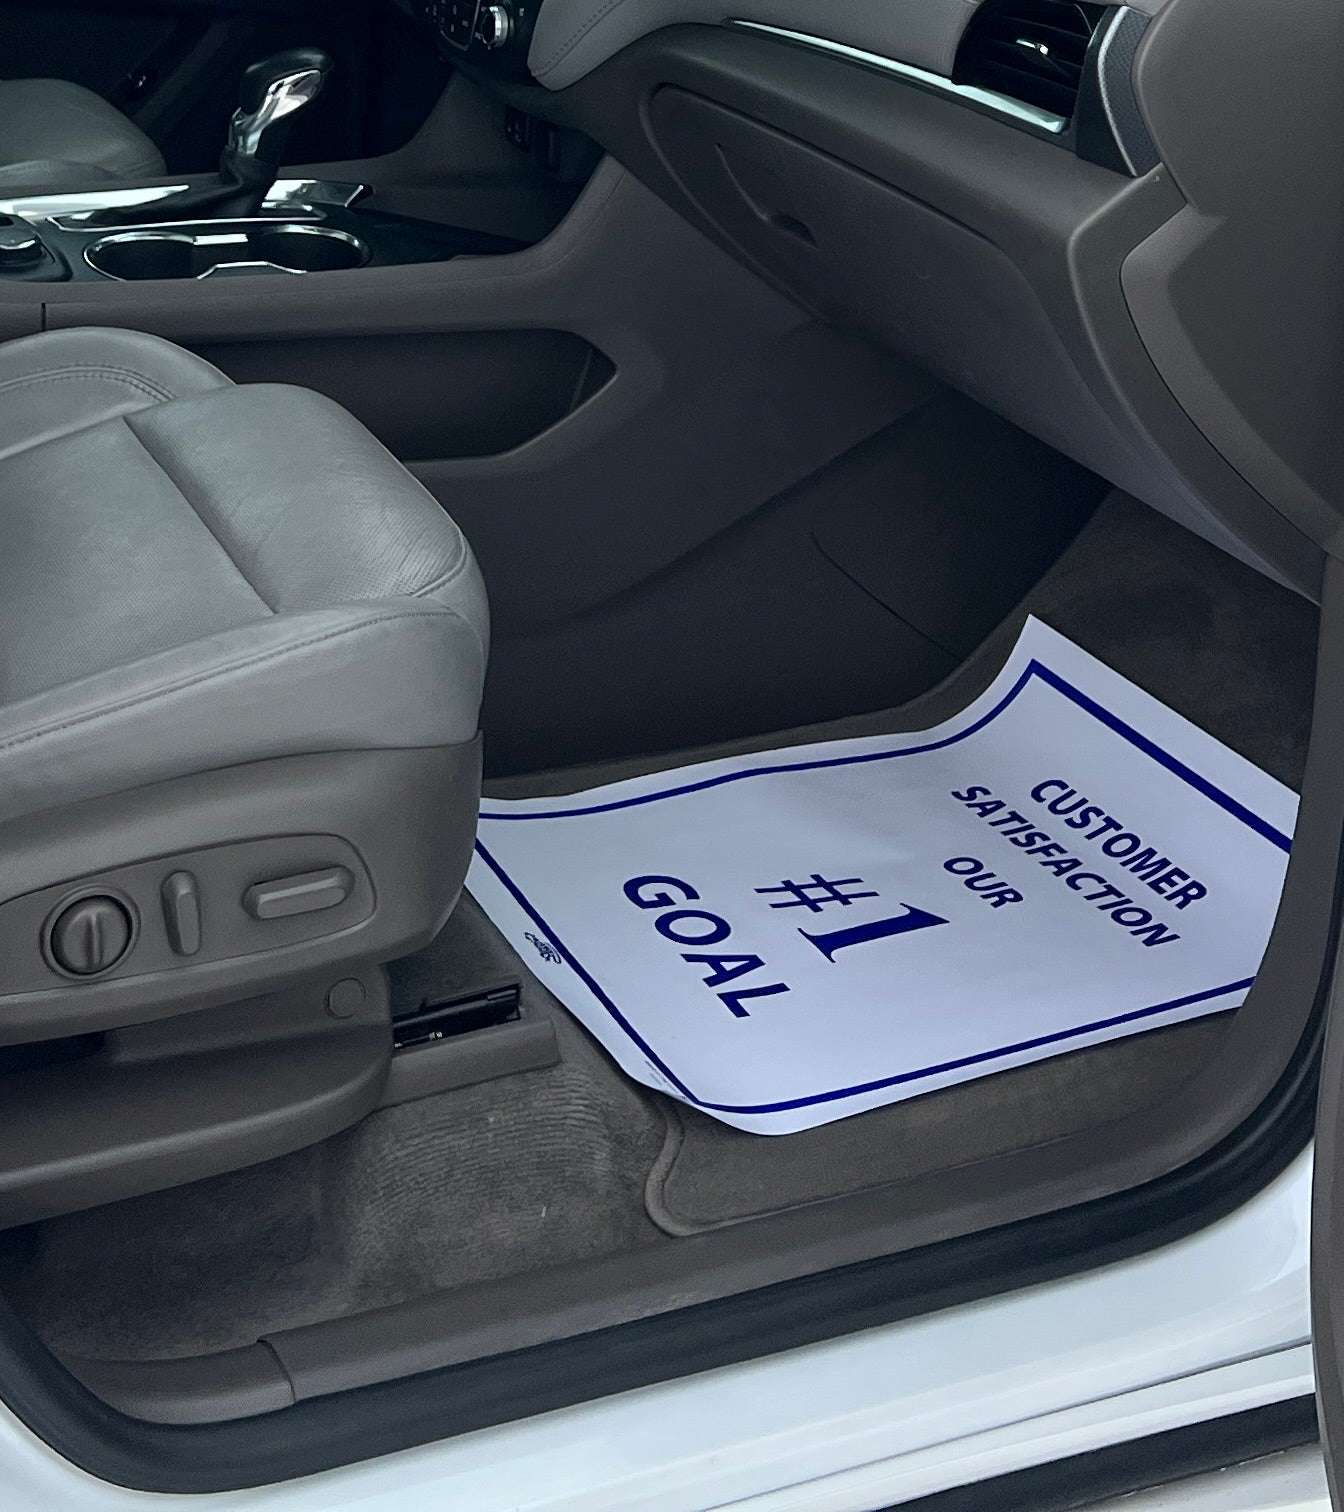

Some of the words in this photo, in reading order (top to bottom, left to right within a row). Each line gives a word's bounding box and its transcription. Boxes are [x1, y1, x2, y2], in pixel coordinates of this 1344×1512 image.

[943, 857, 1024, 908] OUR
[951, 786, 1181, 947] SATISFACTION
[1030, 779, 1207, 910] CUSTOMER
[623, 876, 791, 1018] GOAL
[753, 874, 950, 963] #1
